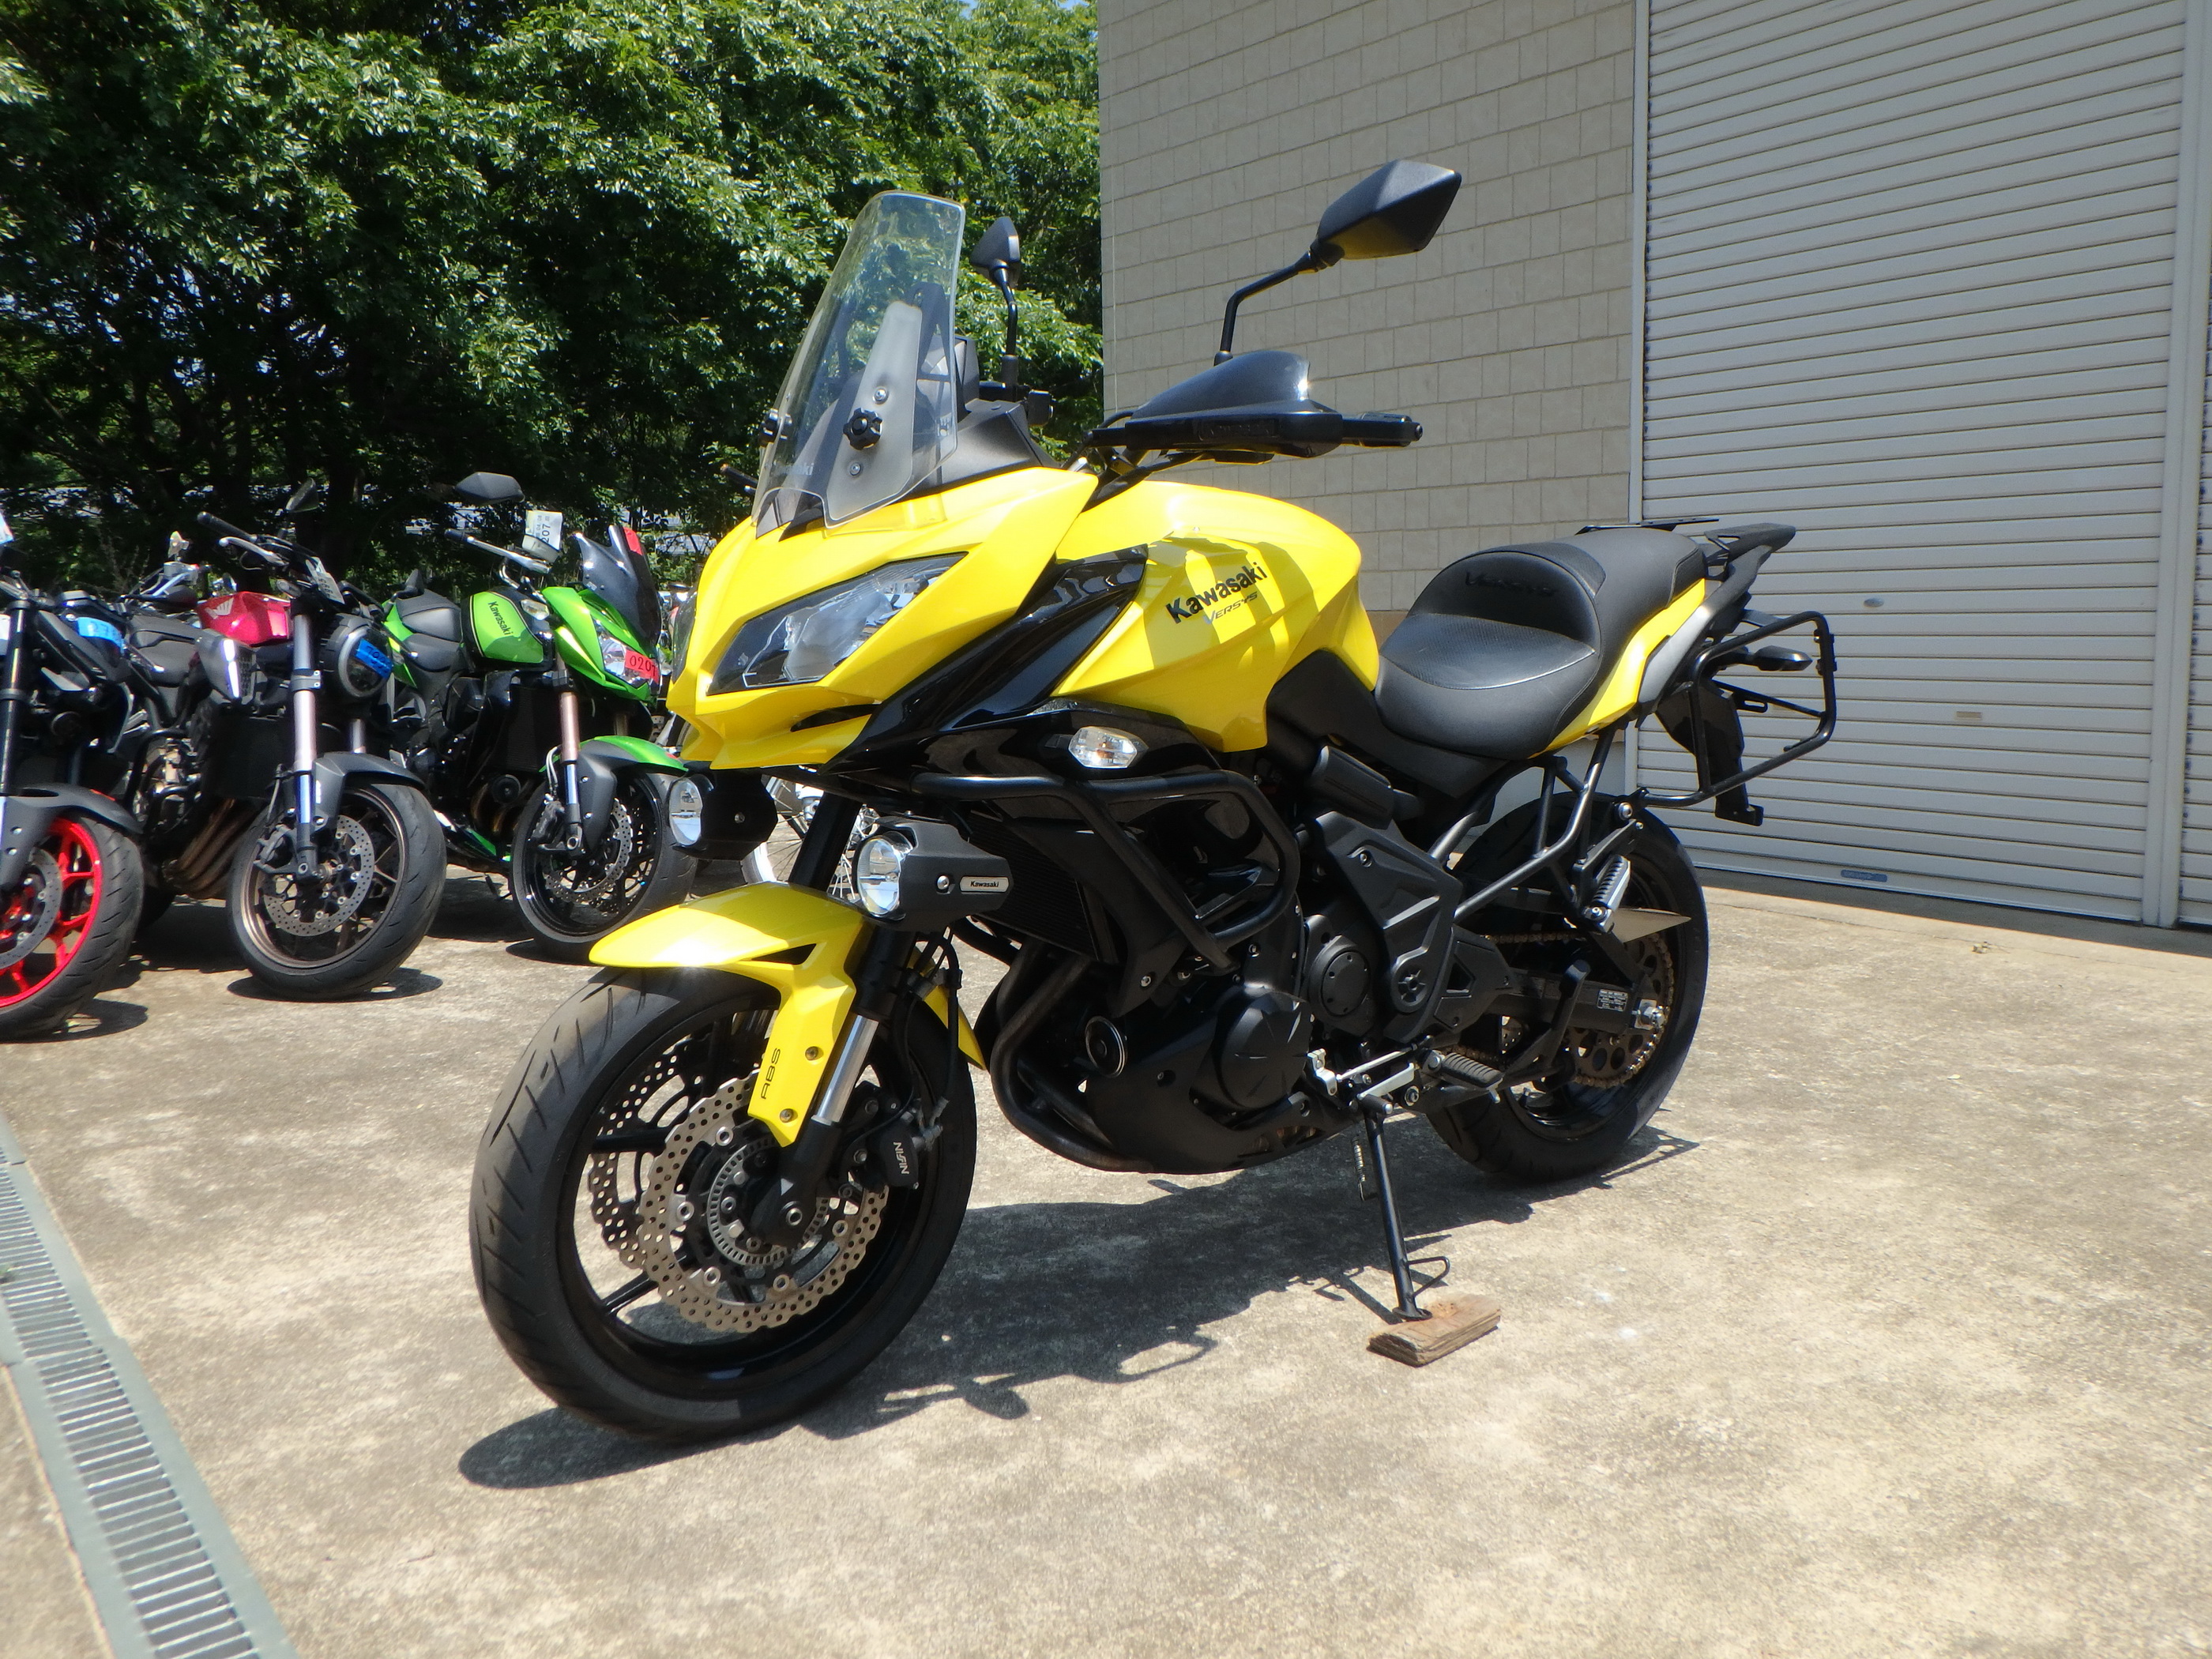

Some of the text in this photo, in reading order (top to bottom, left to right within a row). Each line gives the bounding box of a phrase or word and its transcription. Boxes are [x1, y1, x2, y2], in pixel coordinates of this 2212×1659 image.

[1165, 562, 1268, 624] Kawasaki
[1202, 591, 1258, 624] VERSYS
[487, 600, 514, 635] Kawasaki
[630, 655, 656, 677] 0207
[760, 1048, 781, 1100] ABS
